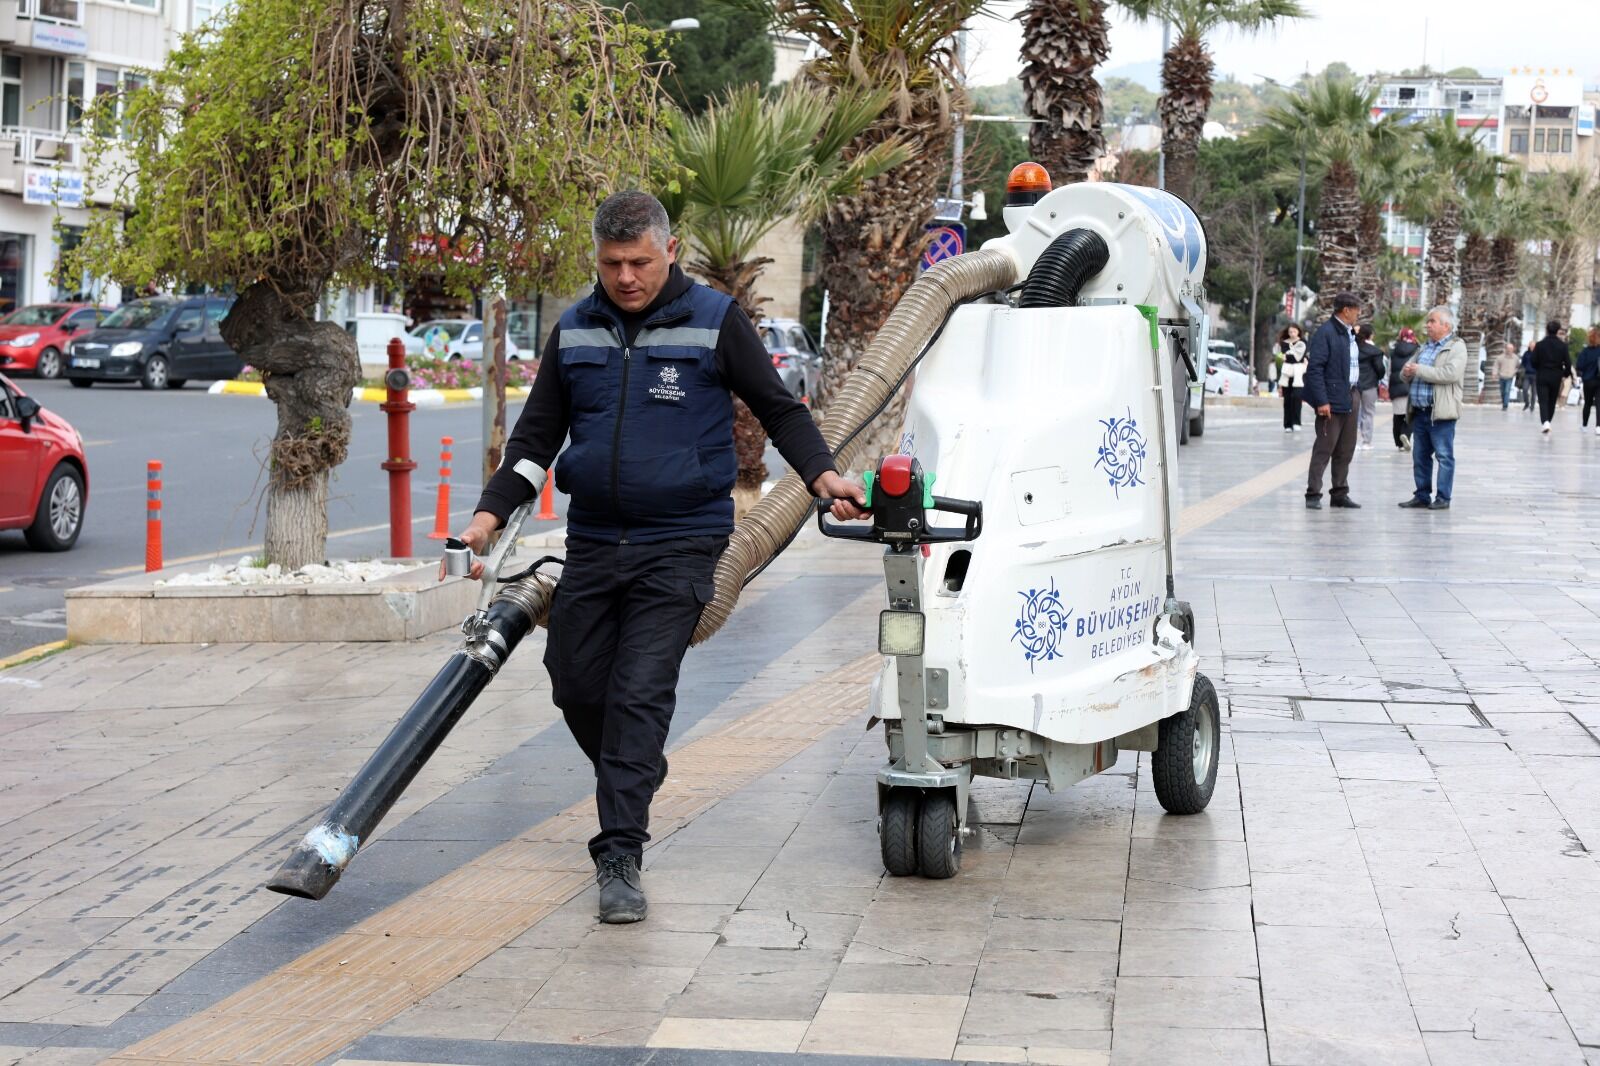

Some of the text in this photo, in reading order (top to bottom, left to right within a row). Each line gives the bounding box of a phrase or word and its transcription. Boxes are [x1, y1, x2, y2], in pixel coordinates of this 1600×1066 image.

[1110, 580, 1141, 602] AYDIN
[1076, 594, 1160, 638] BÜYÜKŞEHİR
[1091, 626, 1146, 659] BELEDİYESİ
